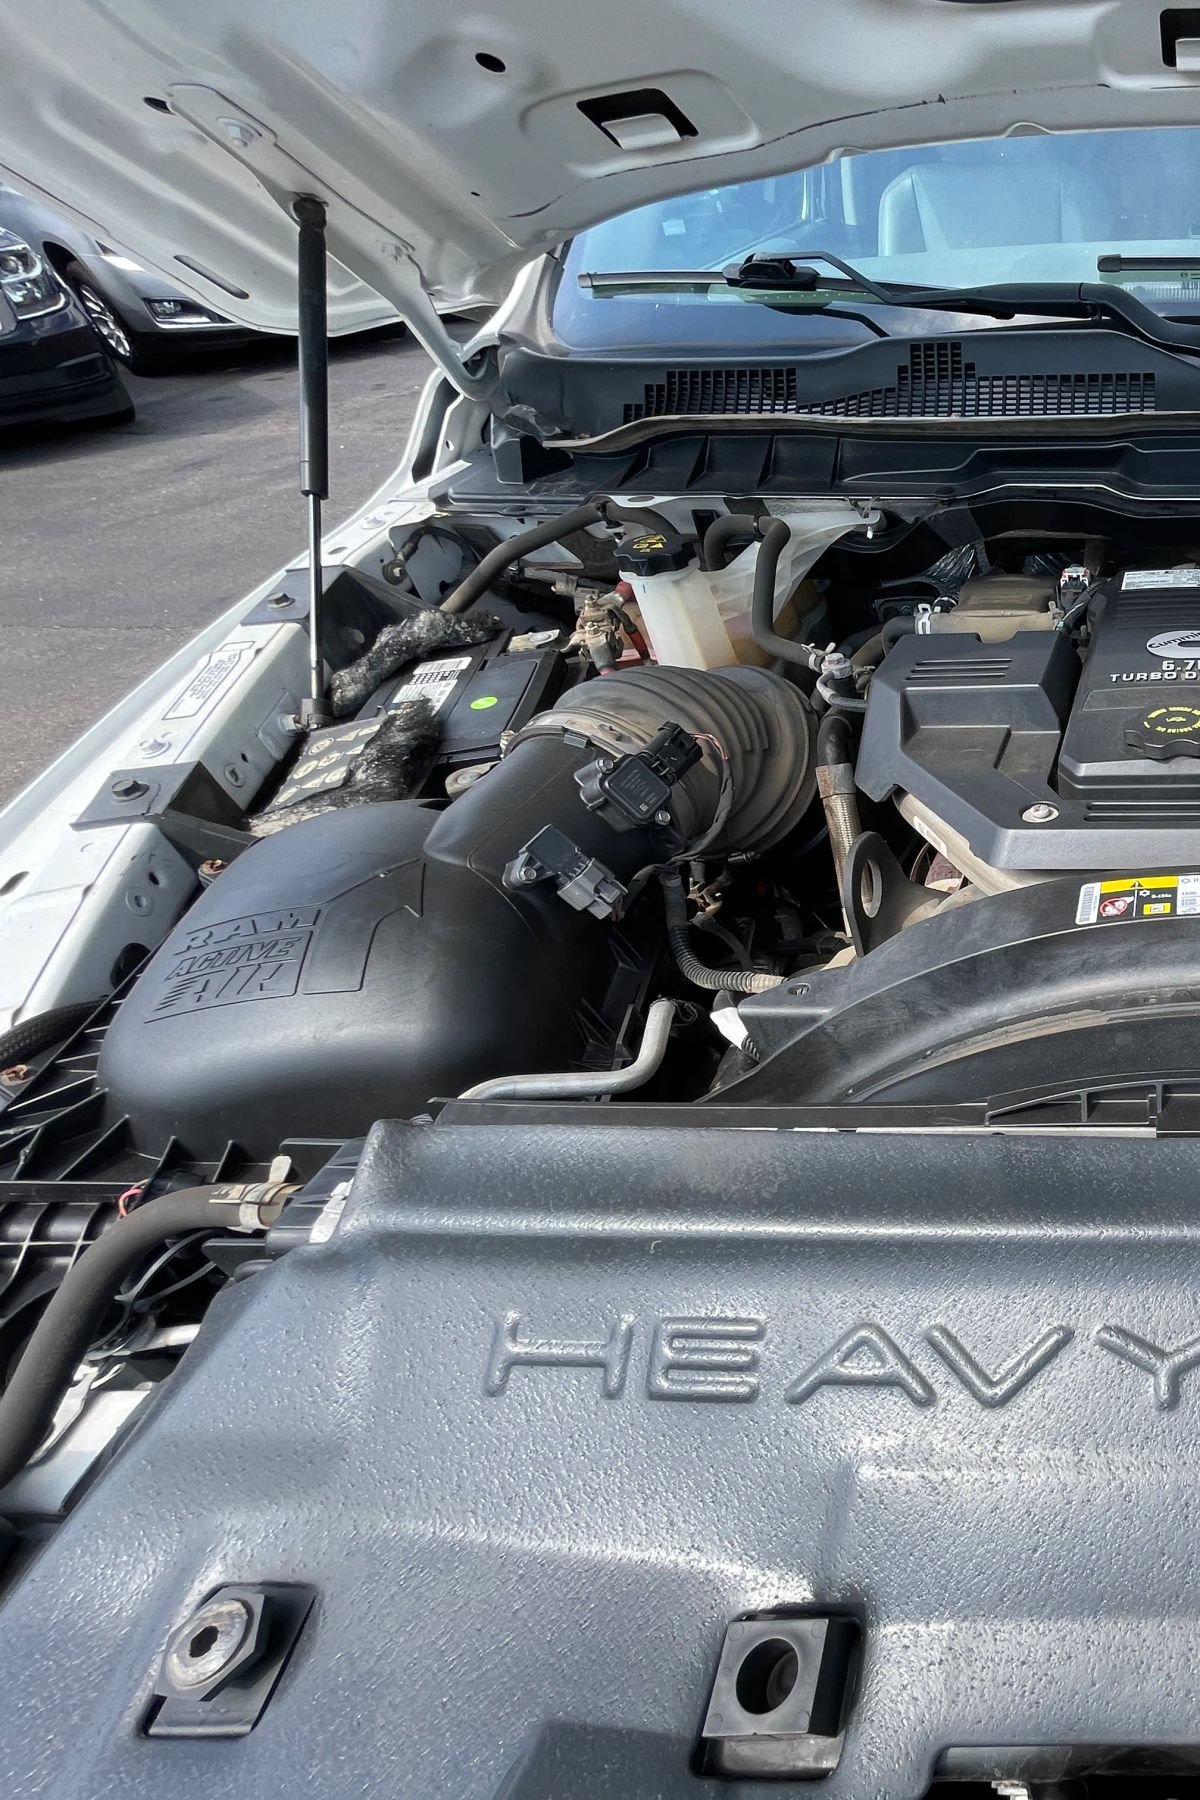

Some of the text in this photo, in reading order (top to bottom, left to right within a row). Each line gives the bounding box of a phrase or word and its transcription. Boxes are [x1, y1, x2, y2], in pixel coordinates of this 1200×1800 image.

[1110, 671, 1178, 683] TURBO
[174, 909, 322, 957] RAM
[164, 936, 305, 981] ACTIVE
